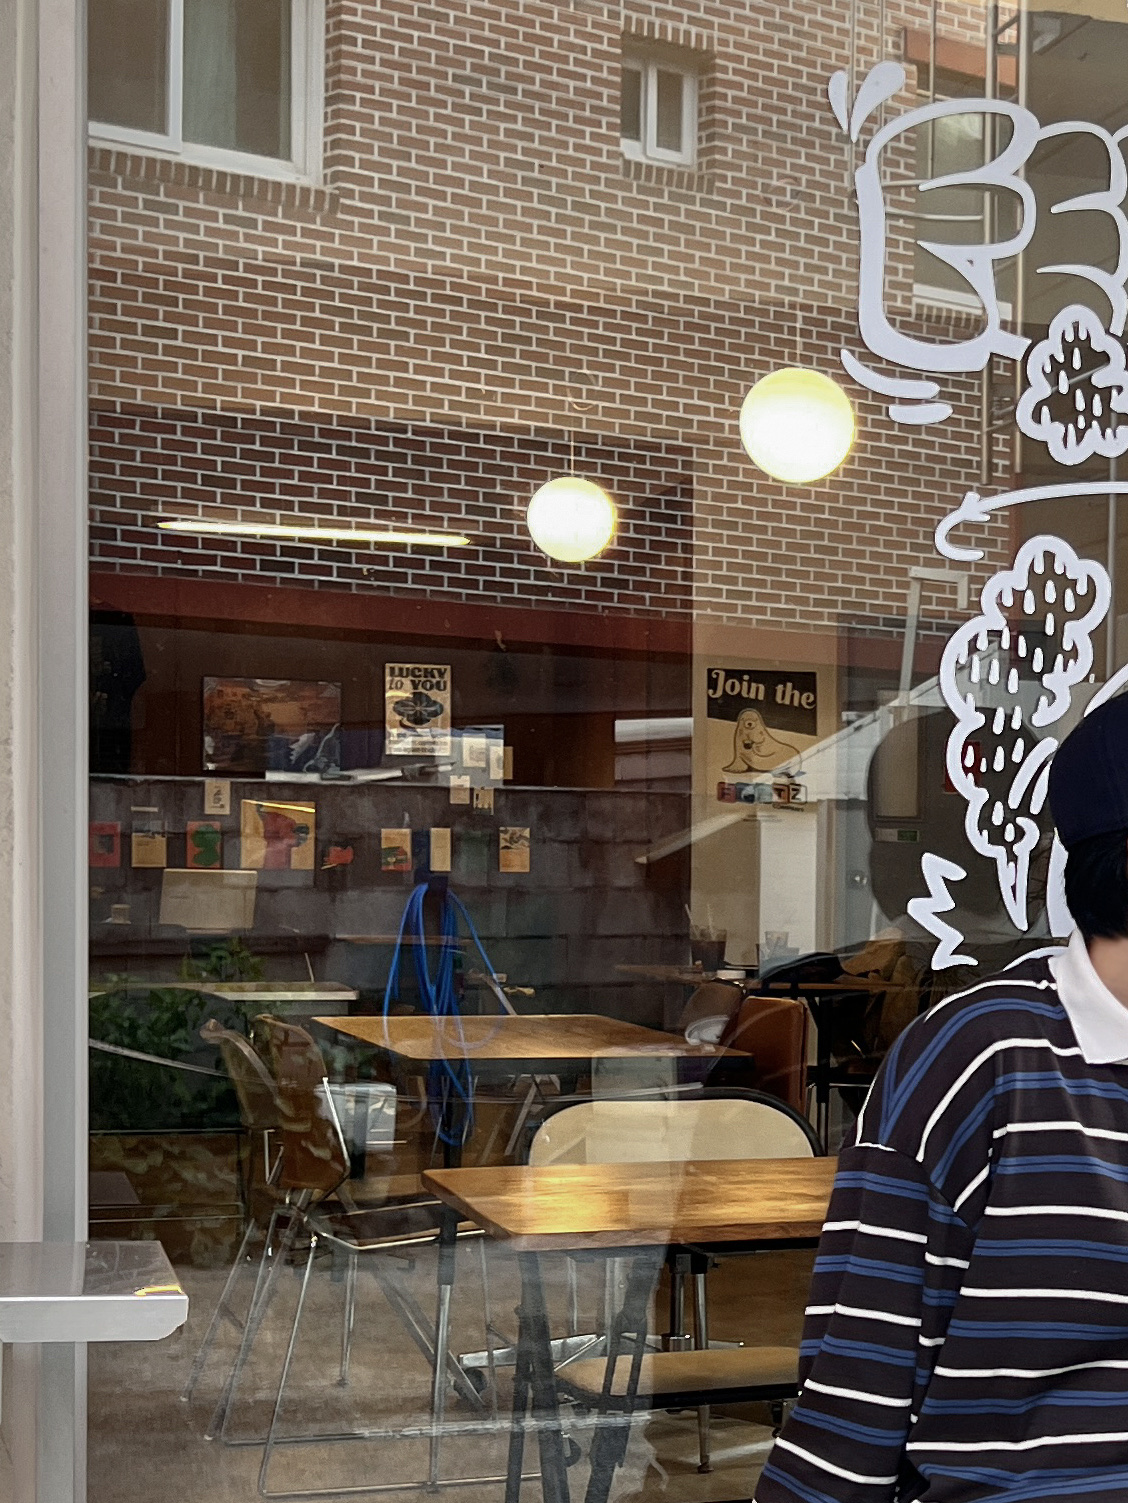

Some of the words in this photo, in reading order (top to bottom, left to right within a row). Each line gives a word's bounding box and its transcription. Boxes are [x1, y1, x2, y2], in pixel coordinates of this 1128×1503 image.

[389, 666, 447, 679] LUCKY
[389, 678, 403, 690] to
[410, 679, 447, 691] YOU
[708, 669, 765, 701] Join
[775, 682, 817, 709] the
